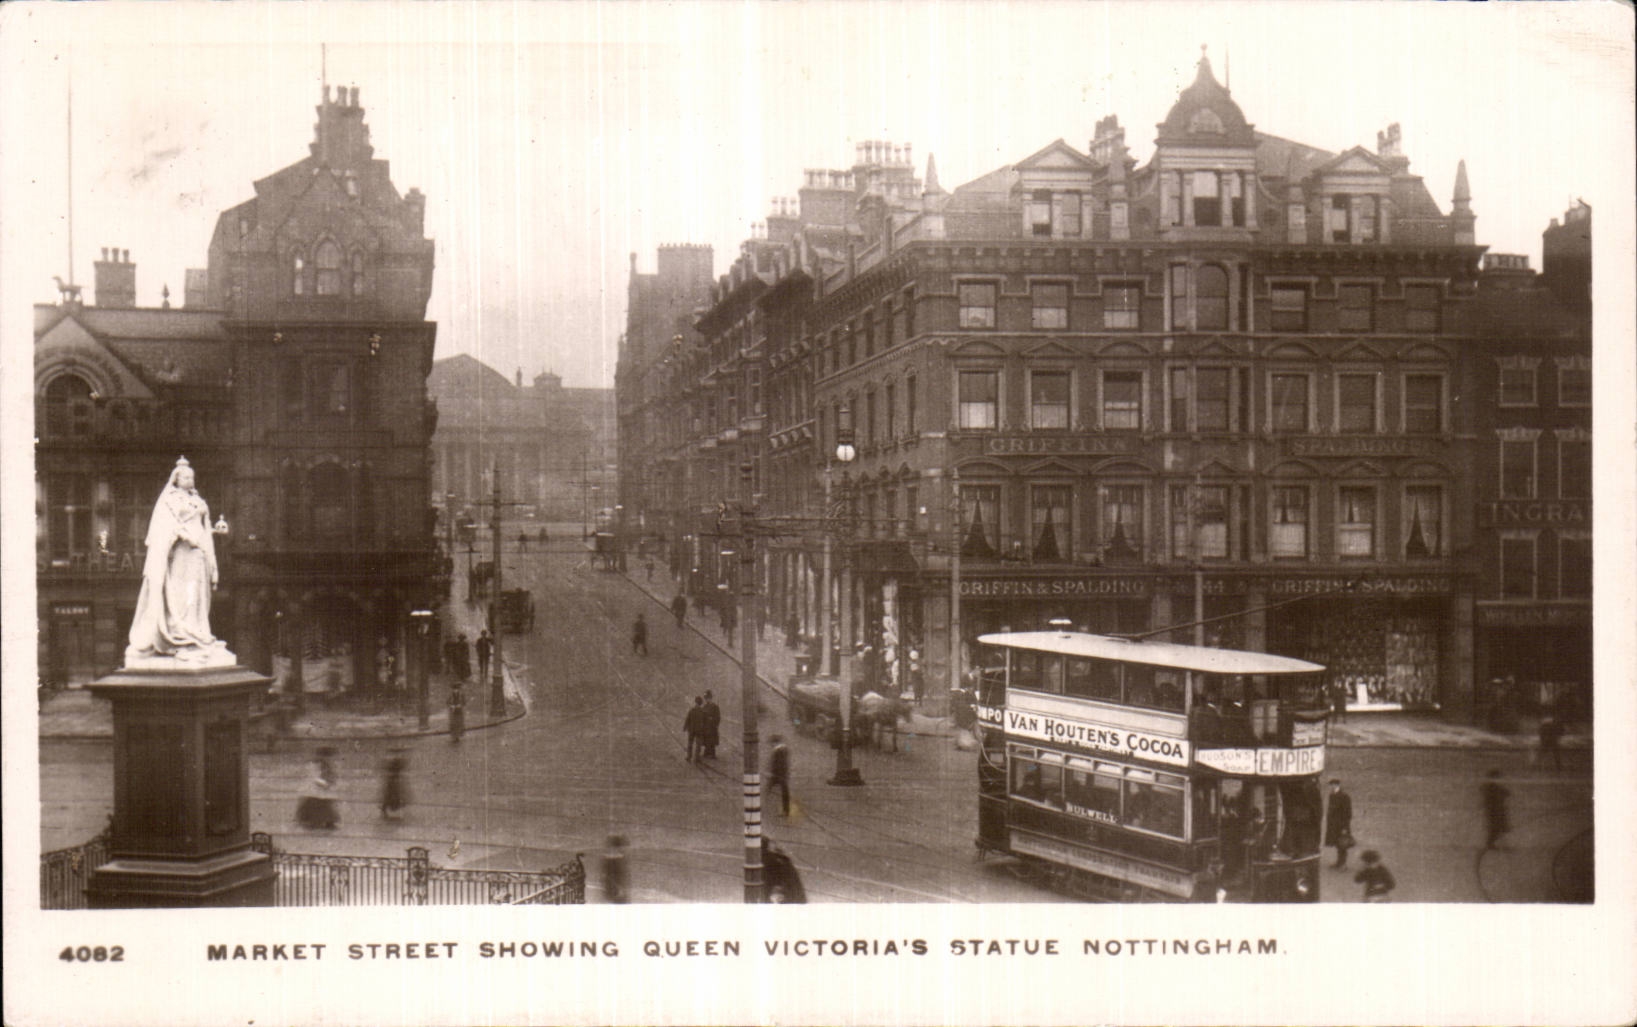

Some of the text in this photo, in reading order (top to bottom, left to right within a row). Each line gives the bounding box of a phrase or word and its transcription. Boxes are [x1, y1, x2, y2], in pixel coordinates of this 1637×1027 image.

[958, 580, 1145, 595] GRIFFIN & SPALDING
[1362, 578, 1450, 593] SPALDING
[1008, 712, 1184, 759] VAN HOUTEN'S COCOA
[1259, 750, 1317, 773] EMPIRE
[1065, 802, 1117, 823] BULWELL
